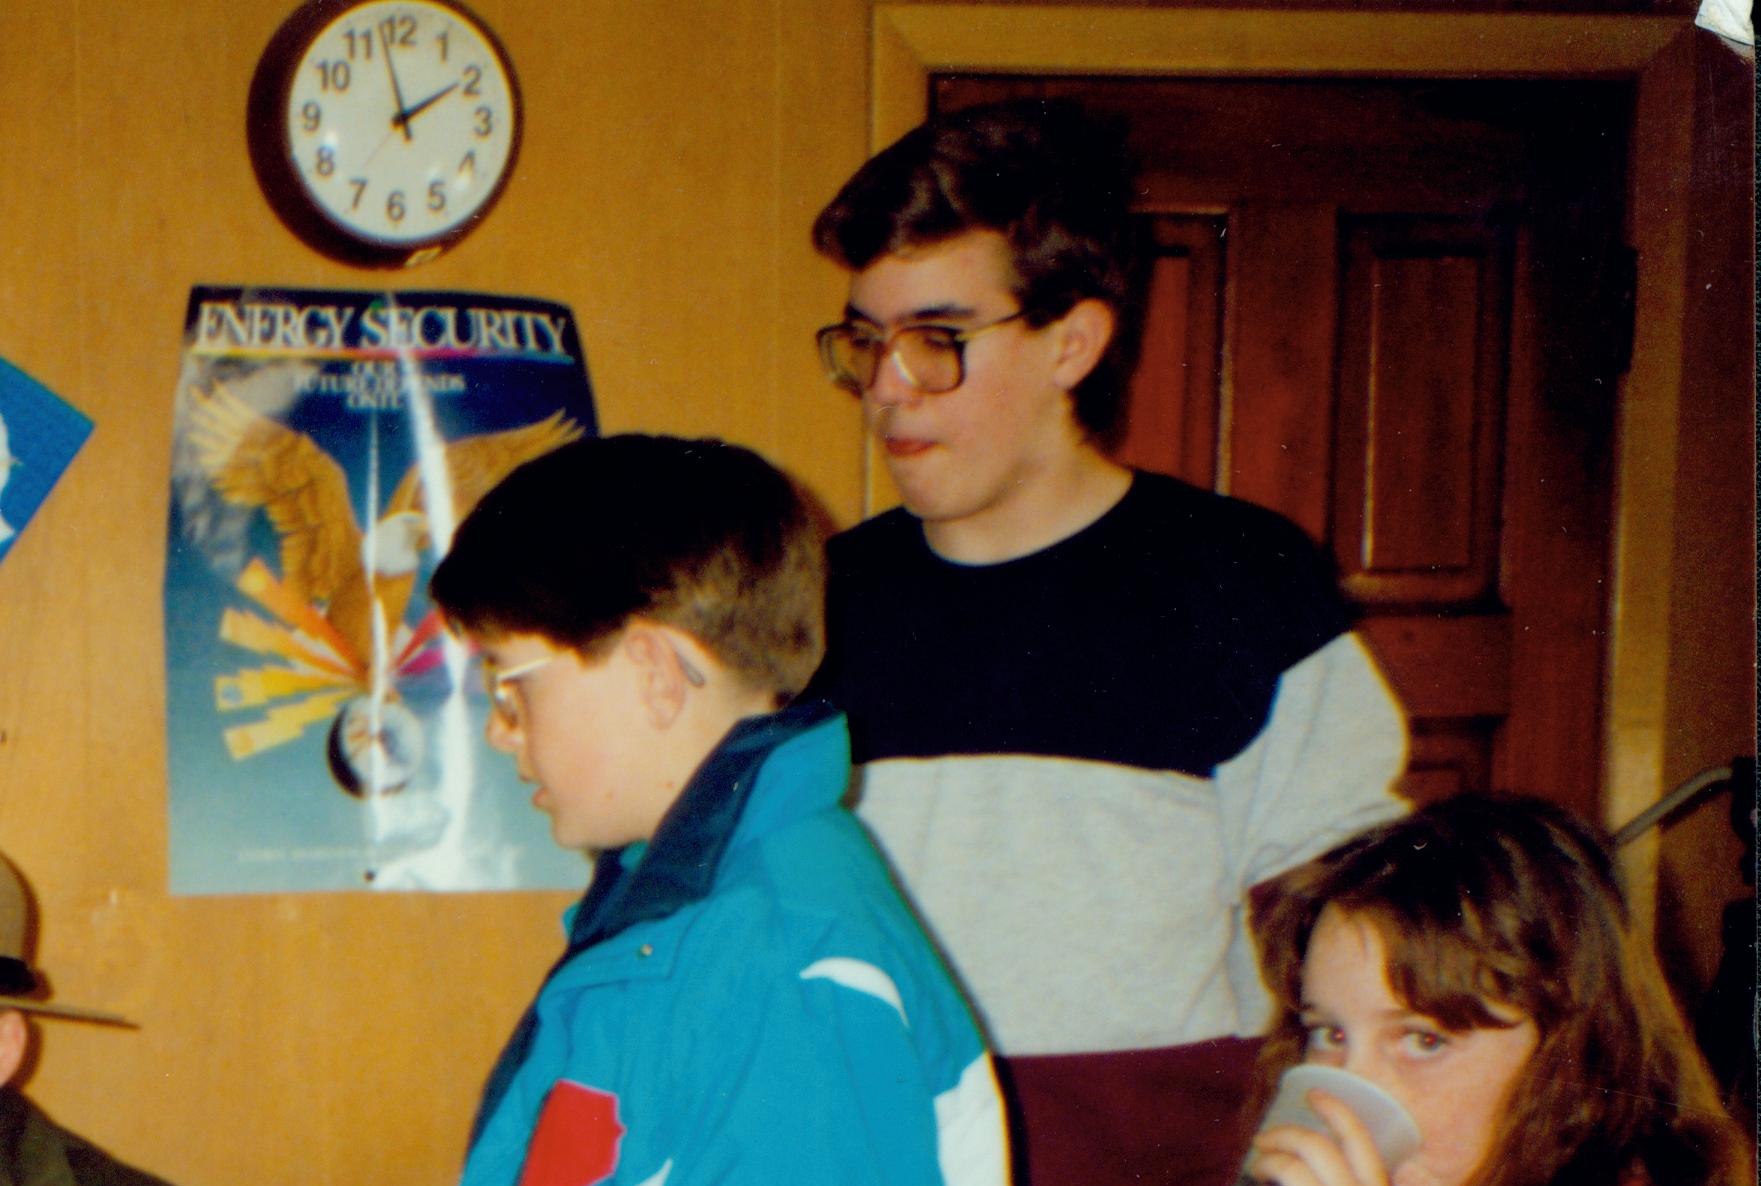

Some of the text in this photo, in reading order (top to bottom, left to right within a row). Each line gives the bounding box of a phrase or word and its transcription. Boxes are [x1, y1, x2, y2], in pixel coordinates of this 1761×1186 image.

[343, 29, 372, 59] 11
[384, 15, 418, 46] 12
[436, 32, 449, 61] 1
[316, 60, 350, 92] 10
[462, 65, 482, 95] 2
[301, 102, 321, 132] 9
[474, 106, 493, 138] 3
[315, 145, 335, 176] 8
[349, 178, 368, 209] 7
[386, 191, 406, 221] 6
[427, 181, 447, 211] 5
[197, 302, 566, 354] ENERGY SECURITY
